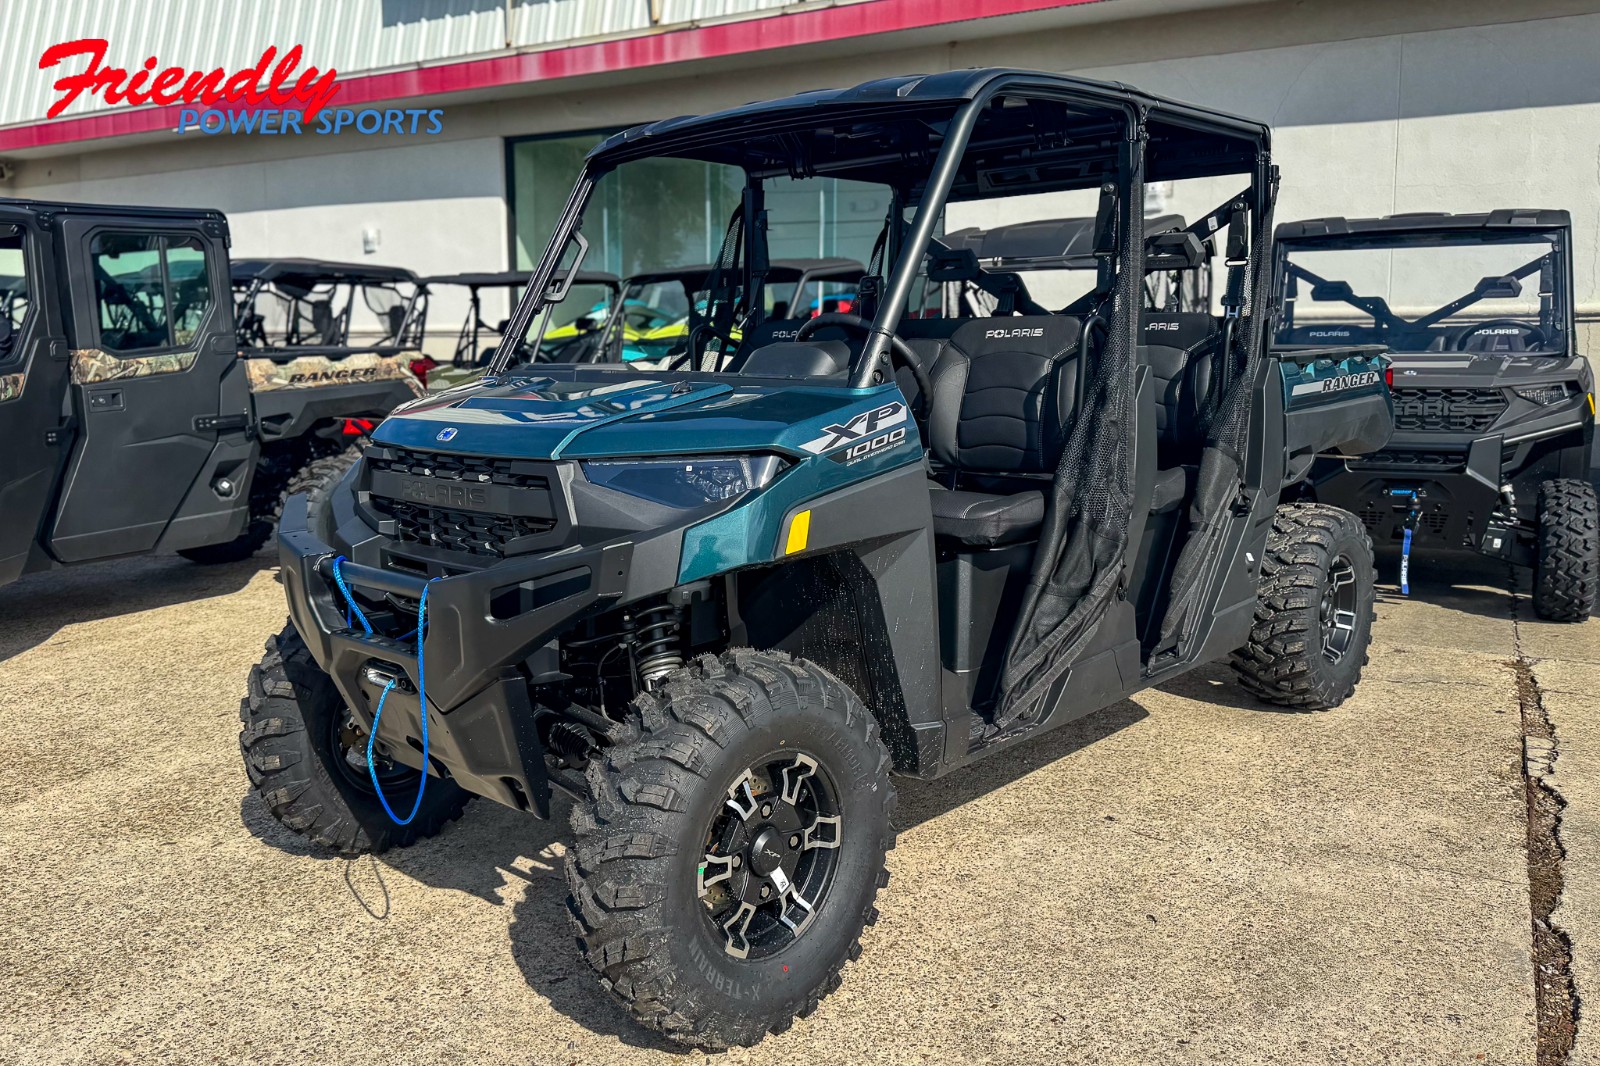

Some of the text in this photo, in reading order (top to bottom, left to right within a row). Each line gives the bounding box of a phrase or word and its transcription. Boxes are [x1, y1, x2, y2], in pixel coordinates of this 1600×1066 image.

[772, 330, 815, 339] POLA
[985, 328, 1044, 339] POLARIS
[1145, 322, 1180, 331] ARIS
[289, 367, 377, 383] RANGER
[1321, 372, 1377, 393] RANGER
[1394, 400, 1469, 416] ARIS
[818, 402, 904, 452] XP
[846, 427, 906, 460] 1000
[401, 480, 487, 506] POLARIS
